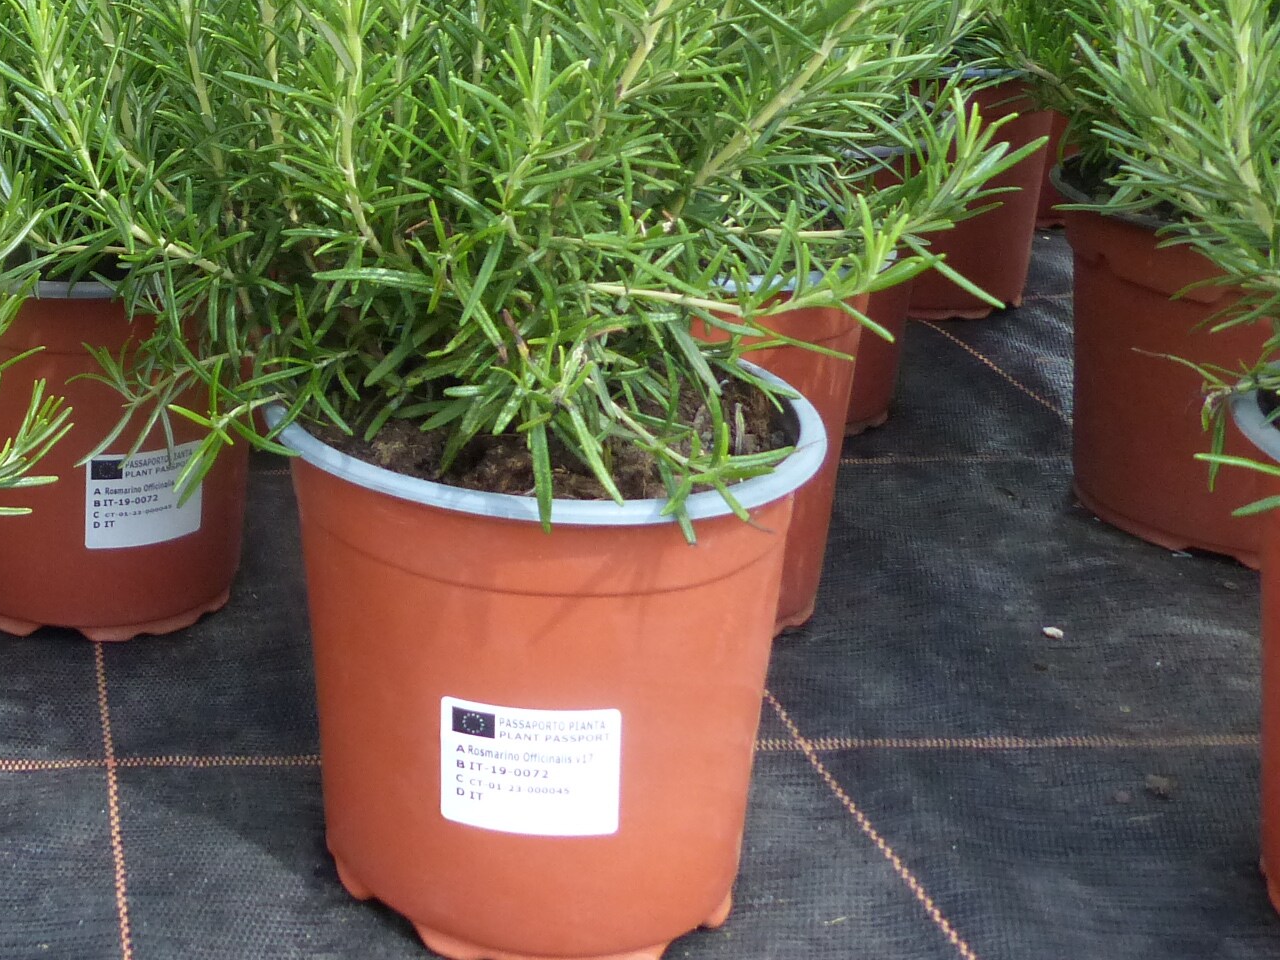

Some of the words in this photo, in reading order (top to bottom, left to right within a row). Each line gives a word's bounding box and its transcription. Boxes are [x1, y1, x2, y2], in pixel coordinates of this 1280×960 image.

[125, 469, 152, 478] PLANT
[93, 487, 101, 495] A
[104, 485, 142, 495] Rosmarino
[103, 494, 158, 507] IT-19-0072
[104, 520, 115, 528] IT
[499, 717, 565, 731] PASSAPORTO
[499, 731, 539, 742] PLANT
[544, 732, 610, 743] PASSPORT
[455, 744, 465, 754] A
[467, 744, 520, 762] Rosmarino
[523, 751, 572, 764] Officinalis
[456, 759, 465, 769] B
[469, 761, 549, 779] IT-19-0072
[455, 773, 464, 783] C
[456, 787, 465, 796] D
[469, 790, 484, 801] IT
